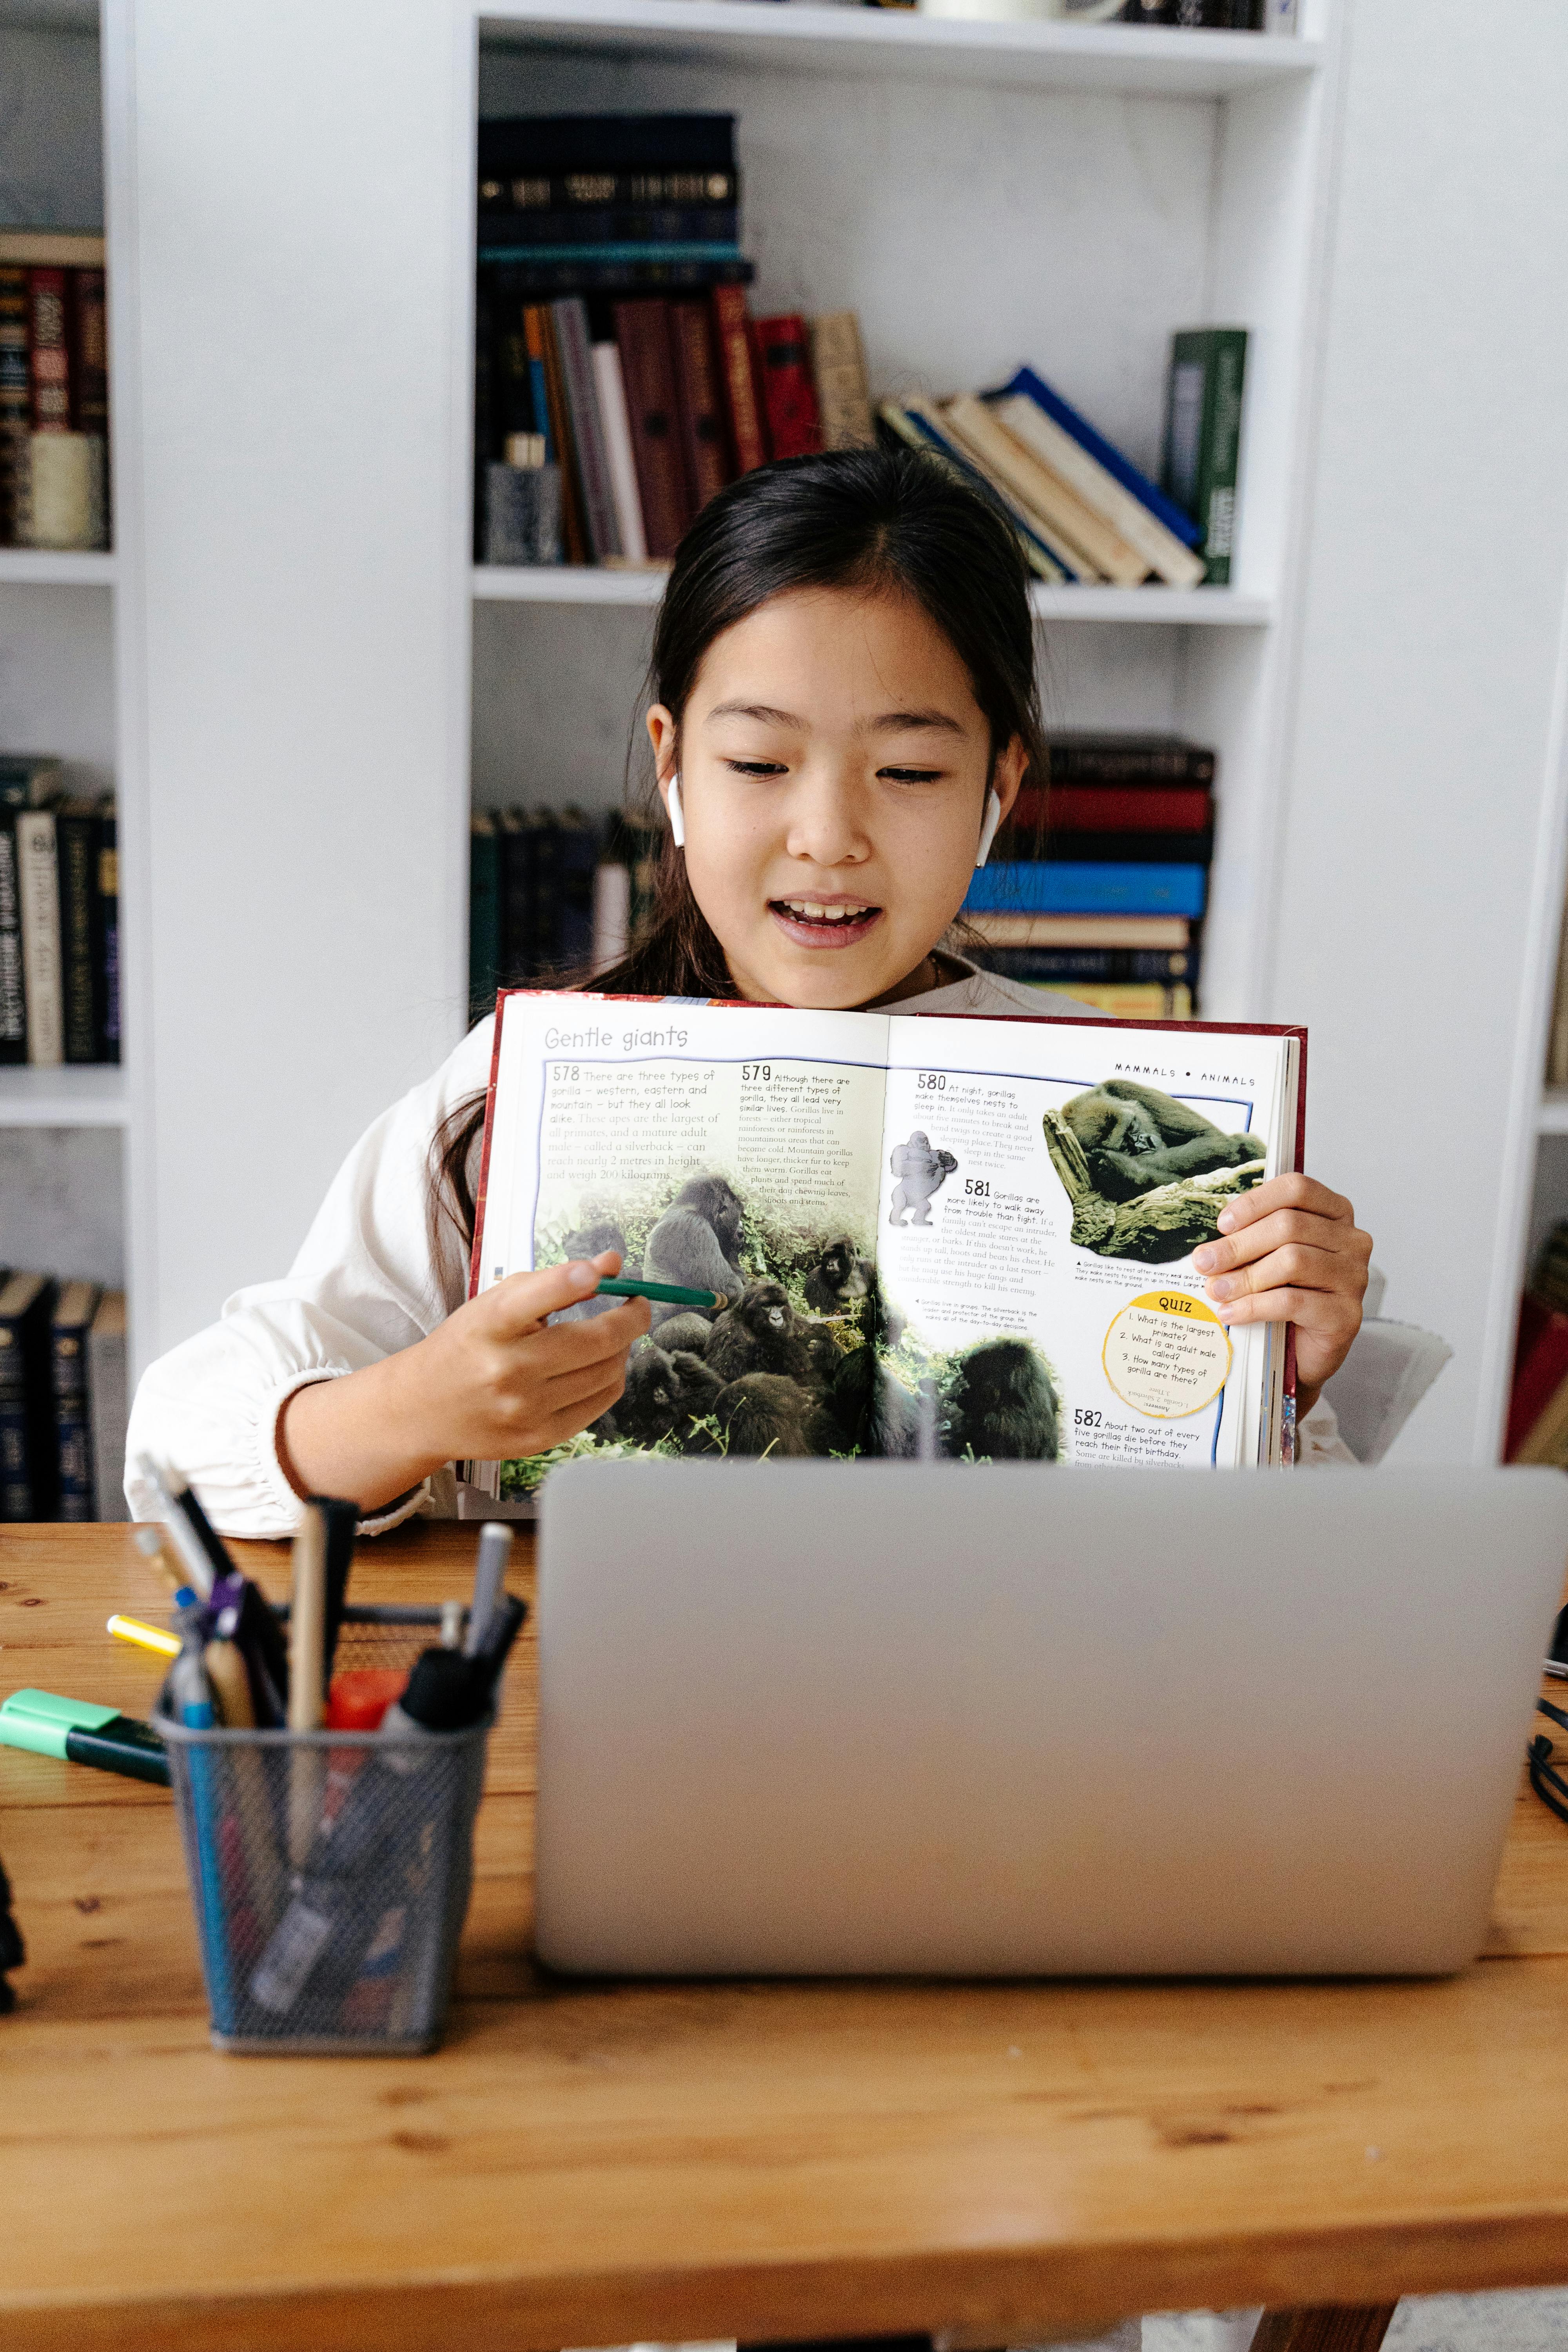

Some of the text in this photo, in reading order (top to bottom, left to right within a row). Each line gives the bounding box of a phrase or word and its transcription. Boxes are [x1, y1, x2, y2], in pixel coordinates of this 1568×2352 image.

[545, 1025, 688, 1052] Gentle giants
[554, 1065, 579, 1082] 578
[583, 1071, 612, 1081] There
[638, 1071, 666, 1081] three
[670, 1071, 699, 1083] types
[704, 1070, 715, 1081] of
[742, 1065, 771, 1081] 579
[774, 1074, 808, 1085] Although
[811, 1076, 833, 1084] there
[1115, 1063, 1255, 1087] MAMMALS ANIMALS
[552, 1084, 707, 1098] gorilla western, eastern and
[766, 1084, 804, 1093] different
[807, 1086, 829, 1095] types
[832, 1086, 841, 1095] of
[918, 1073, 946, 1091] 580
[962, 1087, 984, 1096] night,
[987, 1090, 1016, 1100] gorillas
[551, 1098, 690, 1111] mountain but they all look
[740, 1094, 766, 1103] gorilla,
[770, 1094, 788, 1104] they
[823, 1098, 841, 1106] very
[938, 1094, 980, 1105] themselves
[984, 1100, 1006, 1109] nests
[740, 1104, 764, 1112] similar
[767, 1104, 787, 1113] lives.
[914, 1102, 935, 1112] sleep
[550, 1113, 575, 1123] alike.
[738, 1144, 766, 1152] become
[788, 1146, 824, 1154] Mountain
[827, 1148, 853, 1157] gorillas
[757, 1155, 782, 1165] longer,
[783, 1156, 809, 1164] thicker
[833, 1158, 849, 1168] keep
[546, 1169, 673, 1182] and weigh 200 kilograms.
[743, 1165, 761, 1173] them
[789, 1167, 818, 1175] Gorillas
[751, 1175, 773, 1185] plants
[791, 1177, 812, 1186] spend
[759, 1185, 850, 1198] their day chewing leaves,
[965, 1179, 990, 1197] 581
[994, 1191, 1023, 1203] Gorillas
[764, 1196, 787, 1205] shoots
[969, 1198, 989, 1209] likely
[1024, 1207, 1044, 1216] away
[944, 1206, 962, 1214] from
[965, 1208, 993, 1218] trouble
[996, 1212, 1014, 1221] than
[1017, 1214, 1038, 1225] fight.
[1159, 1297, 1192, 1313] QUIZ
[970, 1319, 1002, 1328] day-to-day
[1138, 1313, 1158, 1325] What
[1160, 1319, 1168, 1328] is
[1171, 1321, 1183, 1331] the
[1186, 1324, 1215, 1337] largest
[1152, 1329, 1187, 1341] primate?
[1132, 1333, 1152, 1345] What
[1155, 1339, 1162, 1348] is
[1177, 1345, 1198, 1354] adult
[1200, 1350, 1216, 1359] male
[1152, 1350, 1180, 1361] called?
[1122, 1352, 1207, 1377] 3. How many types of
[1127, 1366, 1151, 1376] gorilla
[1171, 1373, 1198, 1386] there?
[1128, 1390, 1155, 1401] Silverback
[1149, 1387, 1164, 1396] Three
[1144, 1402, 1170, 1412] Answers:
[1164, 1398, 1183, 1407] Gorilla
[1074, 1408, 1102, 1428] 582
[1104, 1421, 1128, 1432] About
[1131, 1425, 1145, 1433] two
[1164, 1428, 1173, 1437] of
[1176, 1432, 1200, 1441] every
[1074, 1427, 1187, 1450] five gorillas die before they
[1075, 1440, 1181, 1460] reach their first birthday.
[1076, 1449, 1096, 1459] Some
[1112, 1453, 1132, 1463] killed
[1134, 1456, 1143, 1466] by
